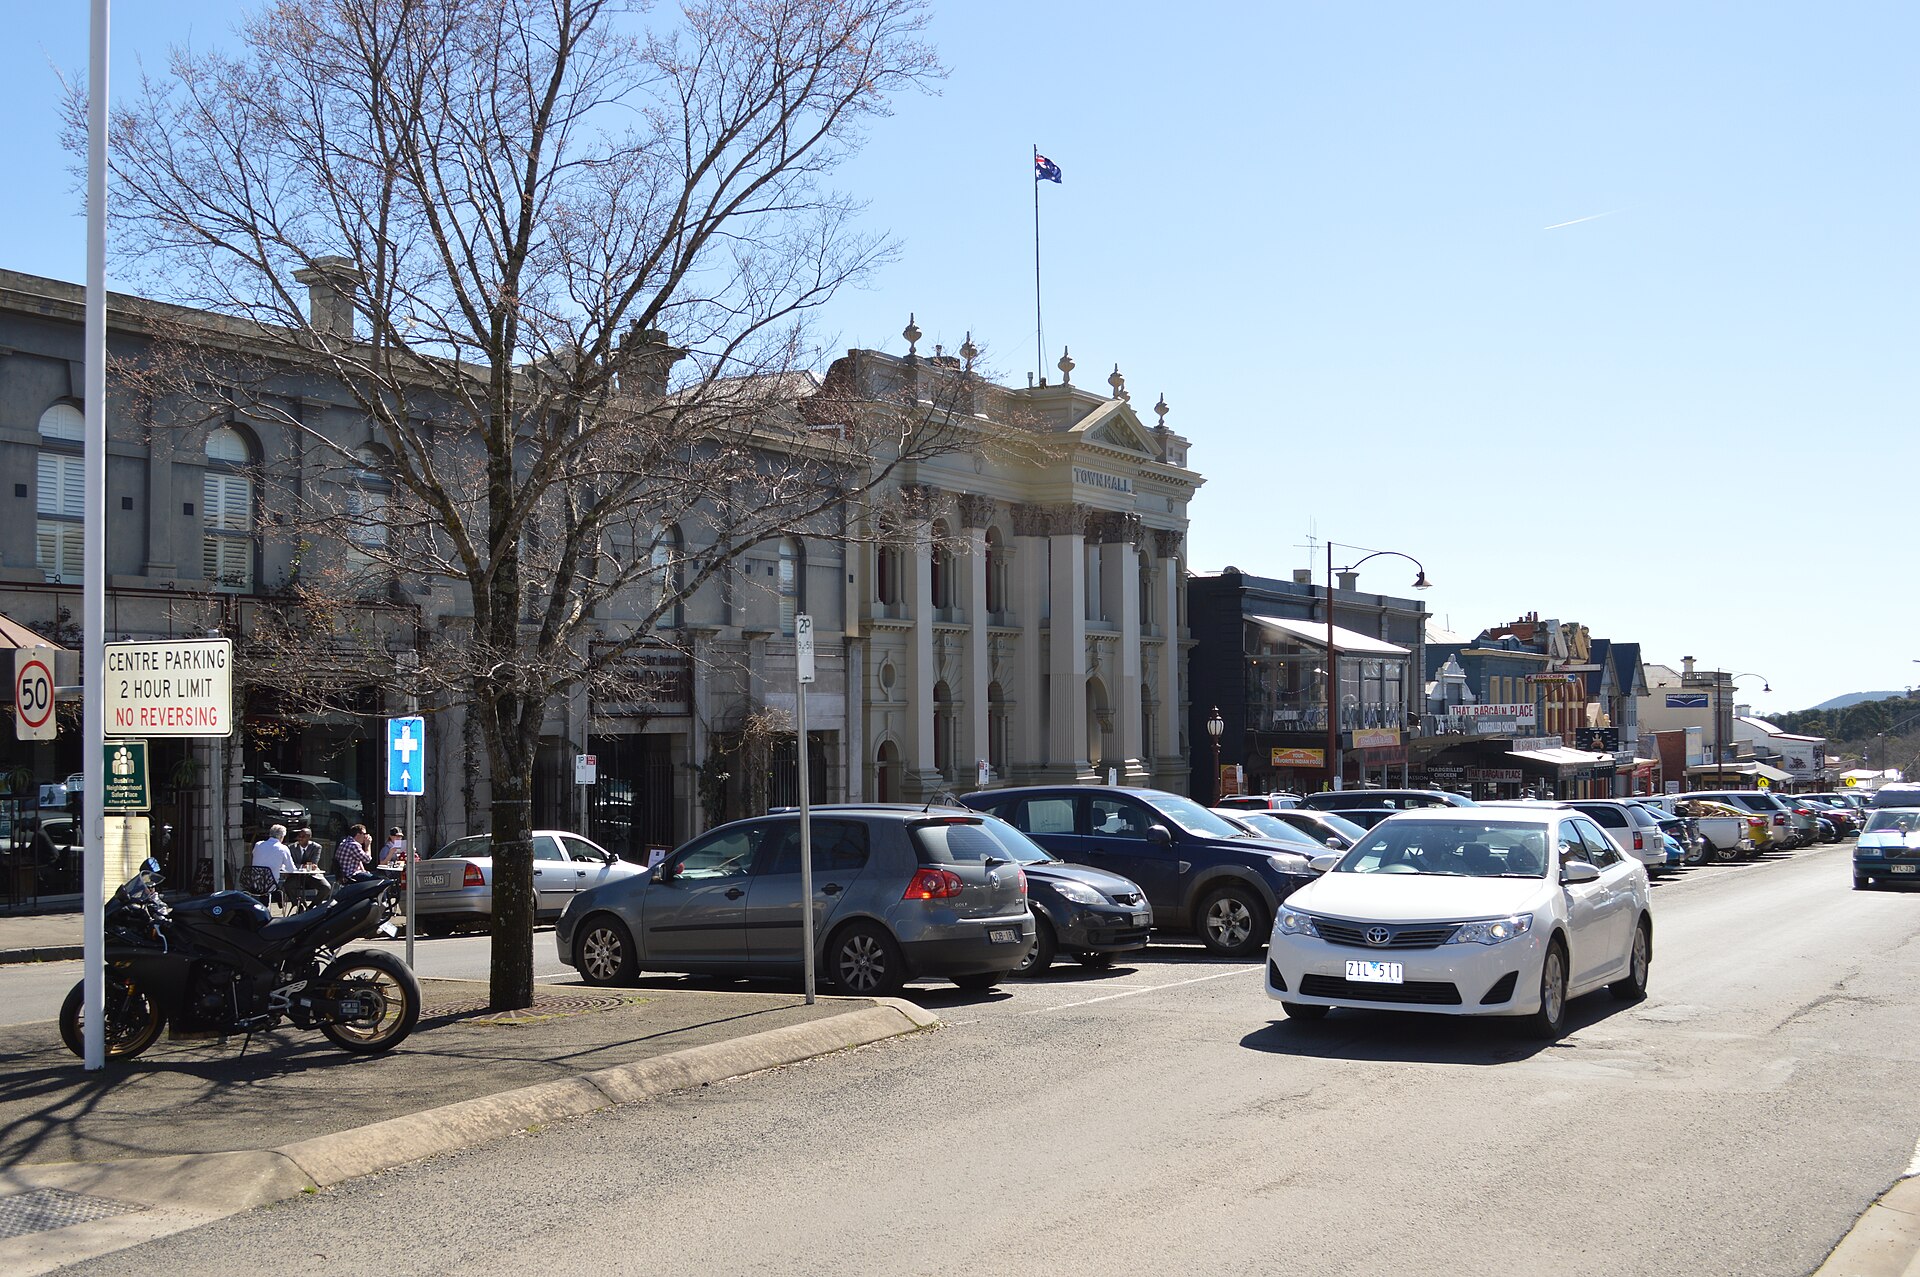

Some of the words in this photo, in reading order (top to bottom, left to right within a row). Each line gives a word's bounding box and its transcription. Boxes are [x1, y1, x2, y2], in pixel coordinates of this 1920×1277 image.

[798, 618, 811, 633] 2P
[108, 651, 159, 671] CENTRE
[165, 649, 225, 670] PARKING
[22, 677, 48, 710] 50
[120, 680, 128, 698] 2
[134, 679, 171, 698] HOUR
[178, 678, 213, 698] LIMIT
[116, 707, 134, 726] NO
[140, 706, 218, 726] REVERSING
[1452, 706, 1471, 716] THAT
[1510, 704, 1534, 717] PLACE
[1482, 769, 1504, 779] BARGAIN
[1505, 769, 1521, 779] PLACE
[1348, 962, 1369, 977] ZIL
